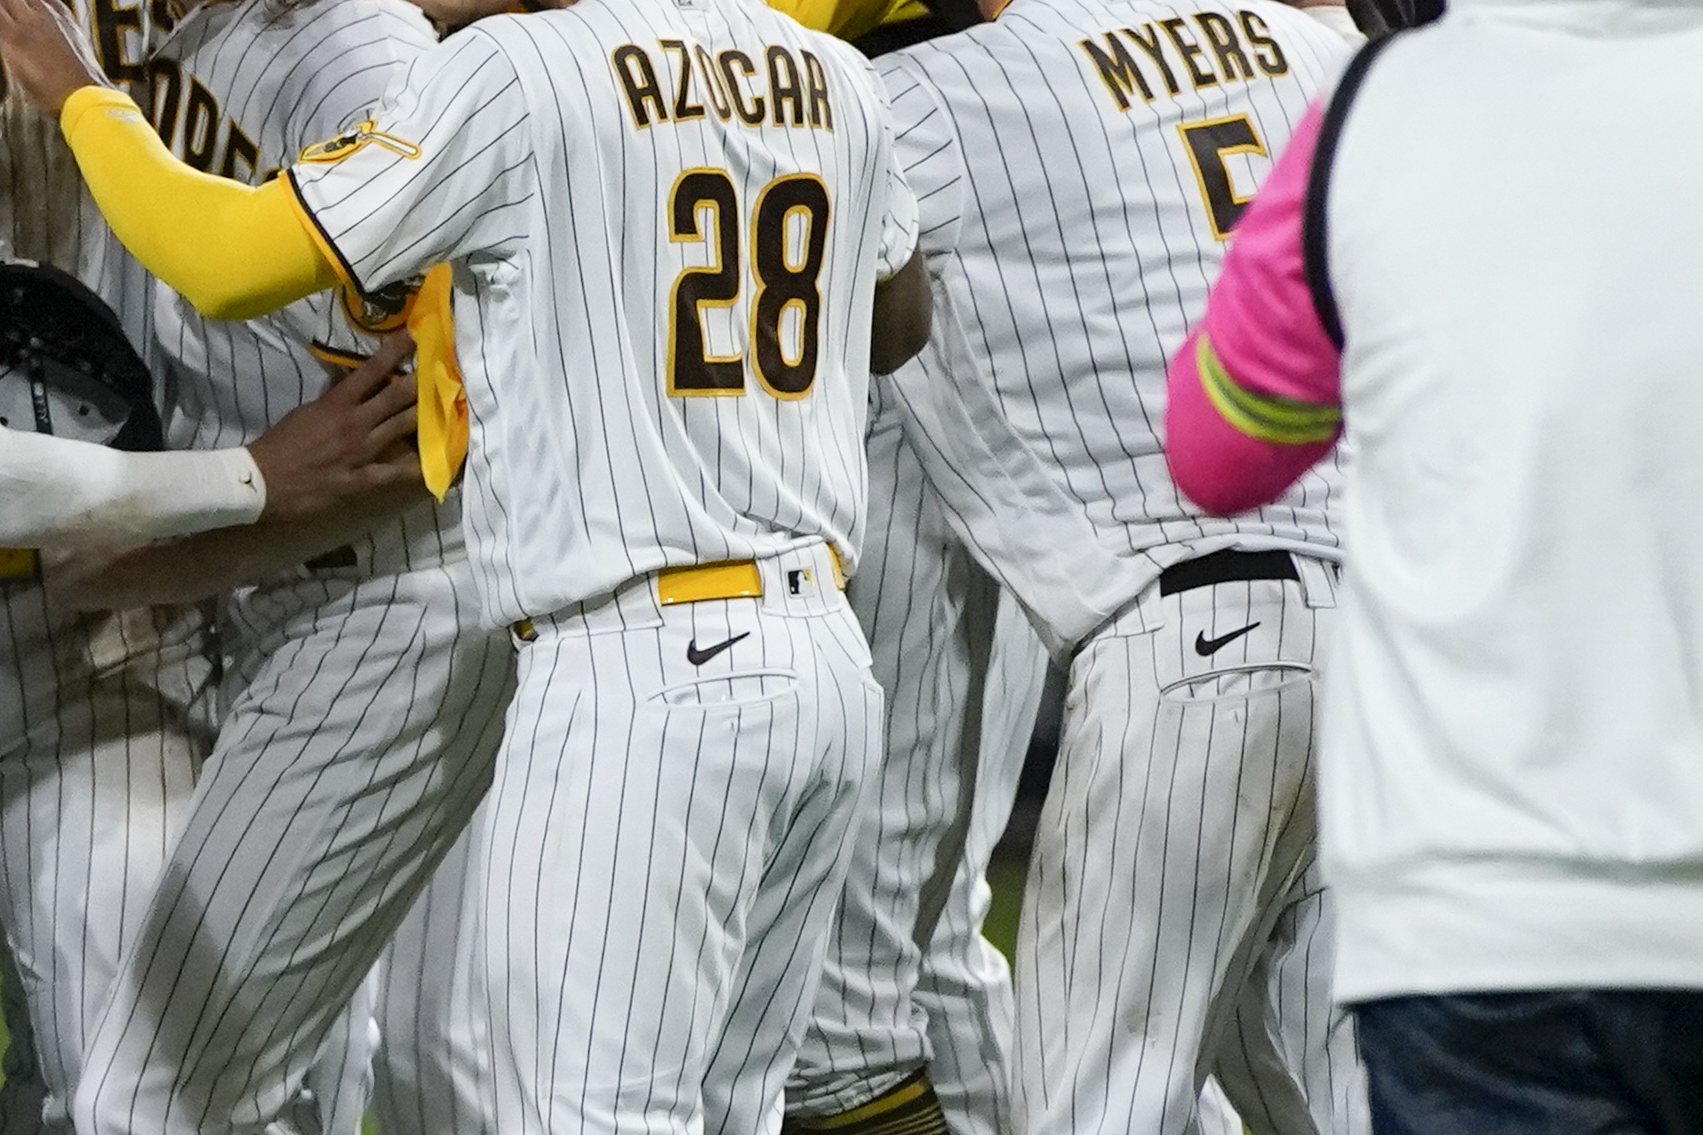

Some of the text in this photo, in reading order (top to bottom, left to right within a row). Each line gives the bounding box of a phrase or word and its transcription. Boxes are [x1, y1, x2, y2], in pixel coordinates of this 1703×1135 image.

[611, 38, 835, 131] AZOCAR
[1078, 9, 1290, 113] MYERS
[667, 167, 834, 401] 28
